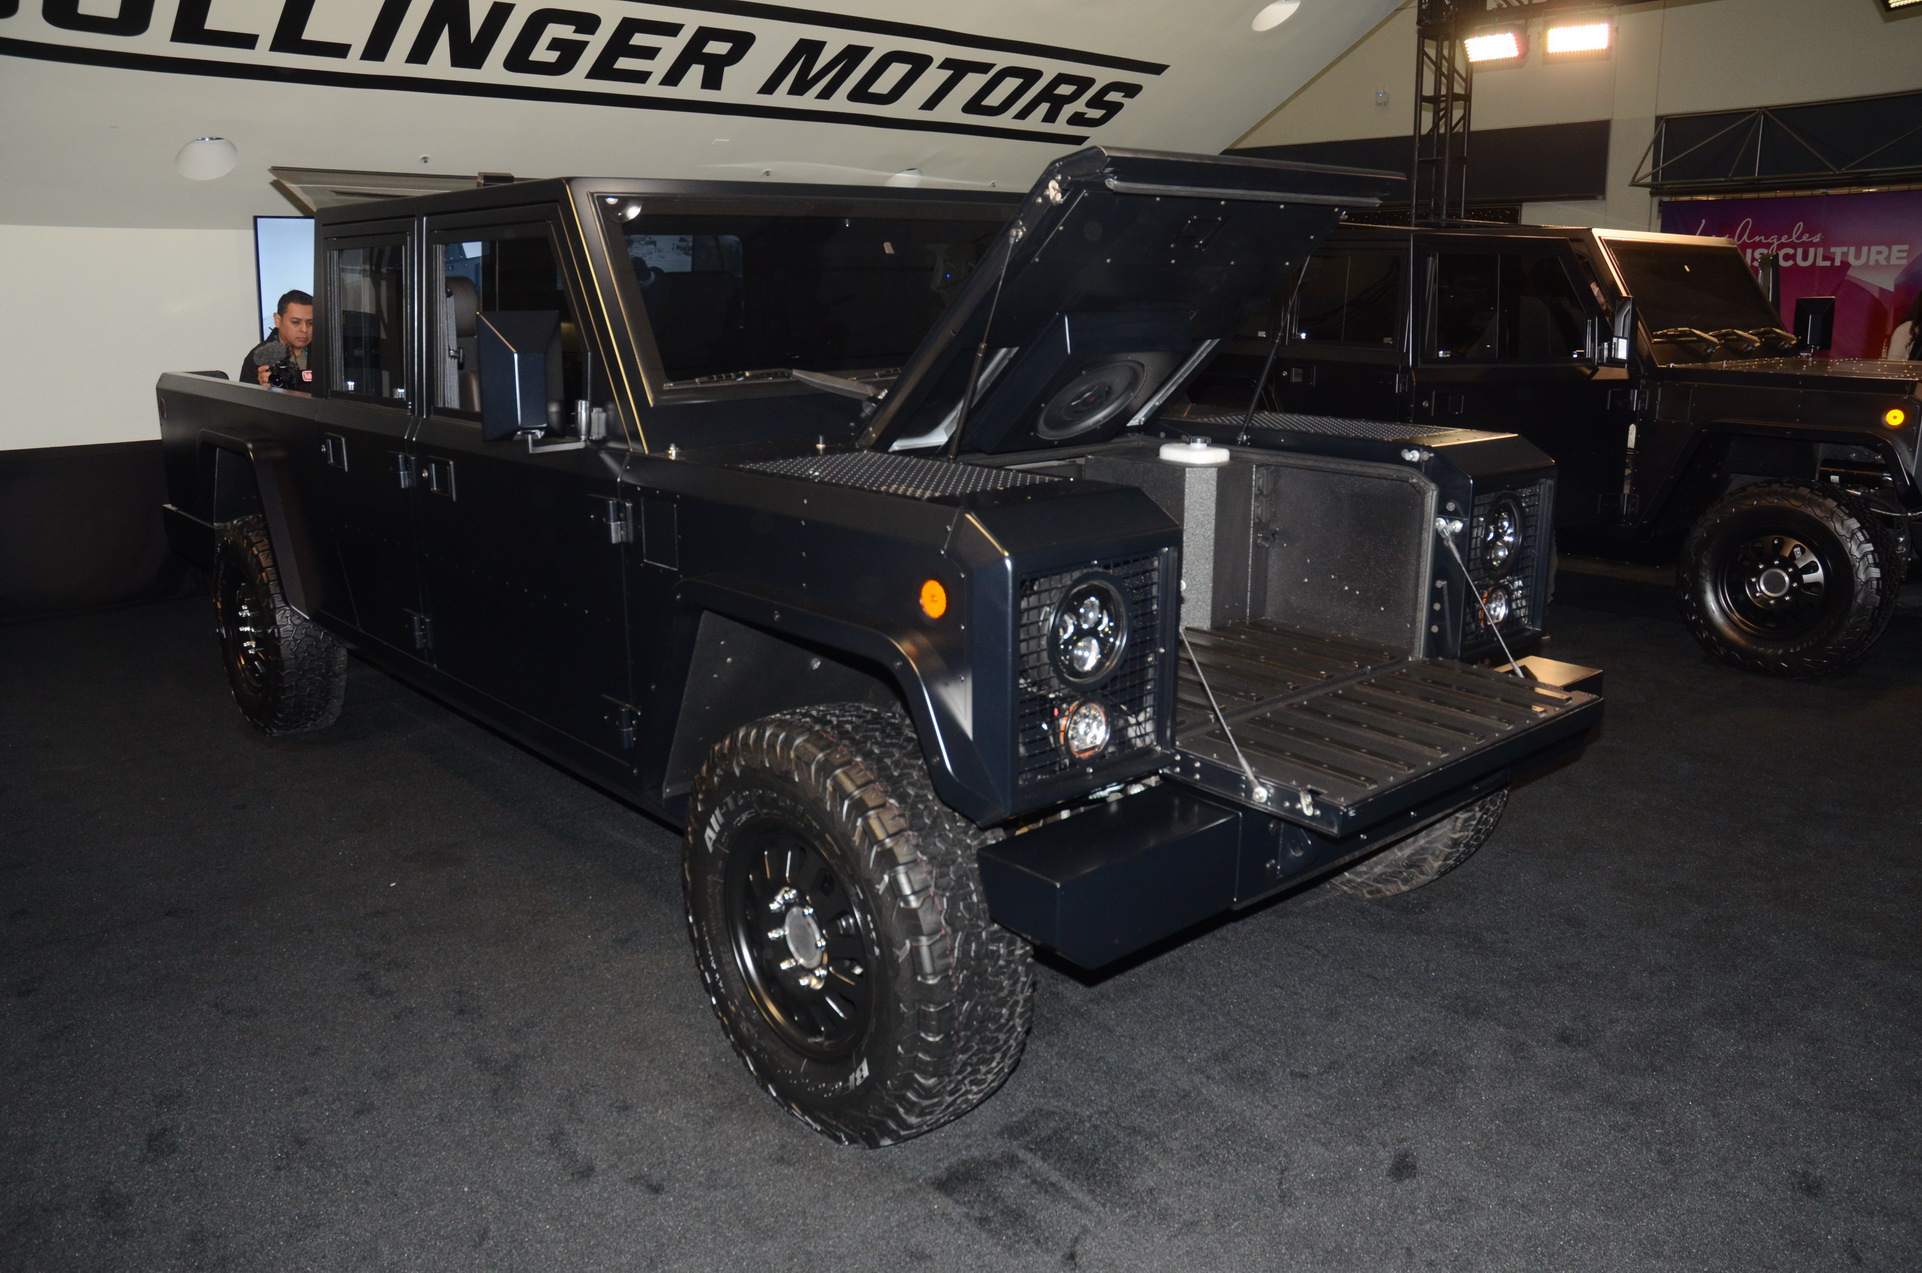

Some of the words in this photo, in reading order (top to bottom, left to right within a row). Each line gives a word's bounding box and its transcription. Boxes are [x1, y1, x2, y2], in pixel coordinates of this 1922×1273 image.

[756, 38, 1144, 128] MOTORS
[1734, 217, 1824, 253] Angeles
[1778, 244, 1909, 267] CULTURE
